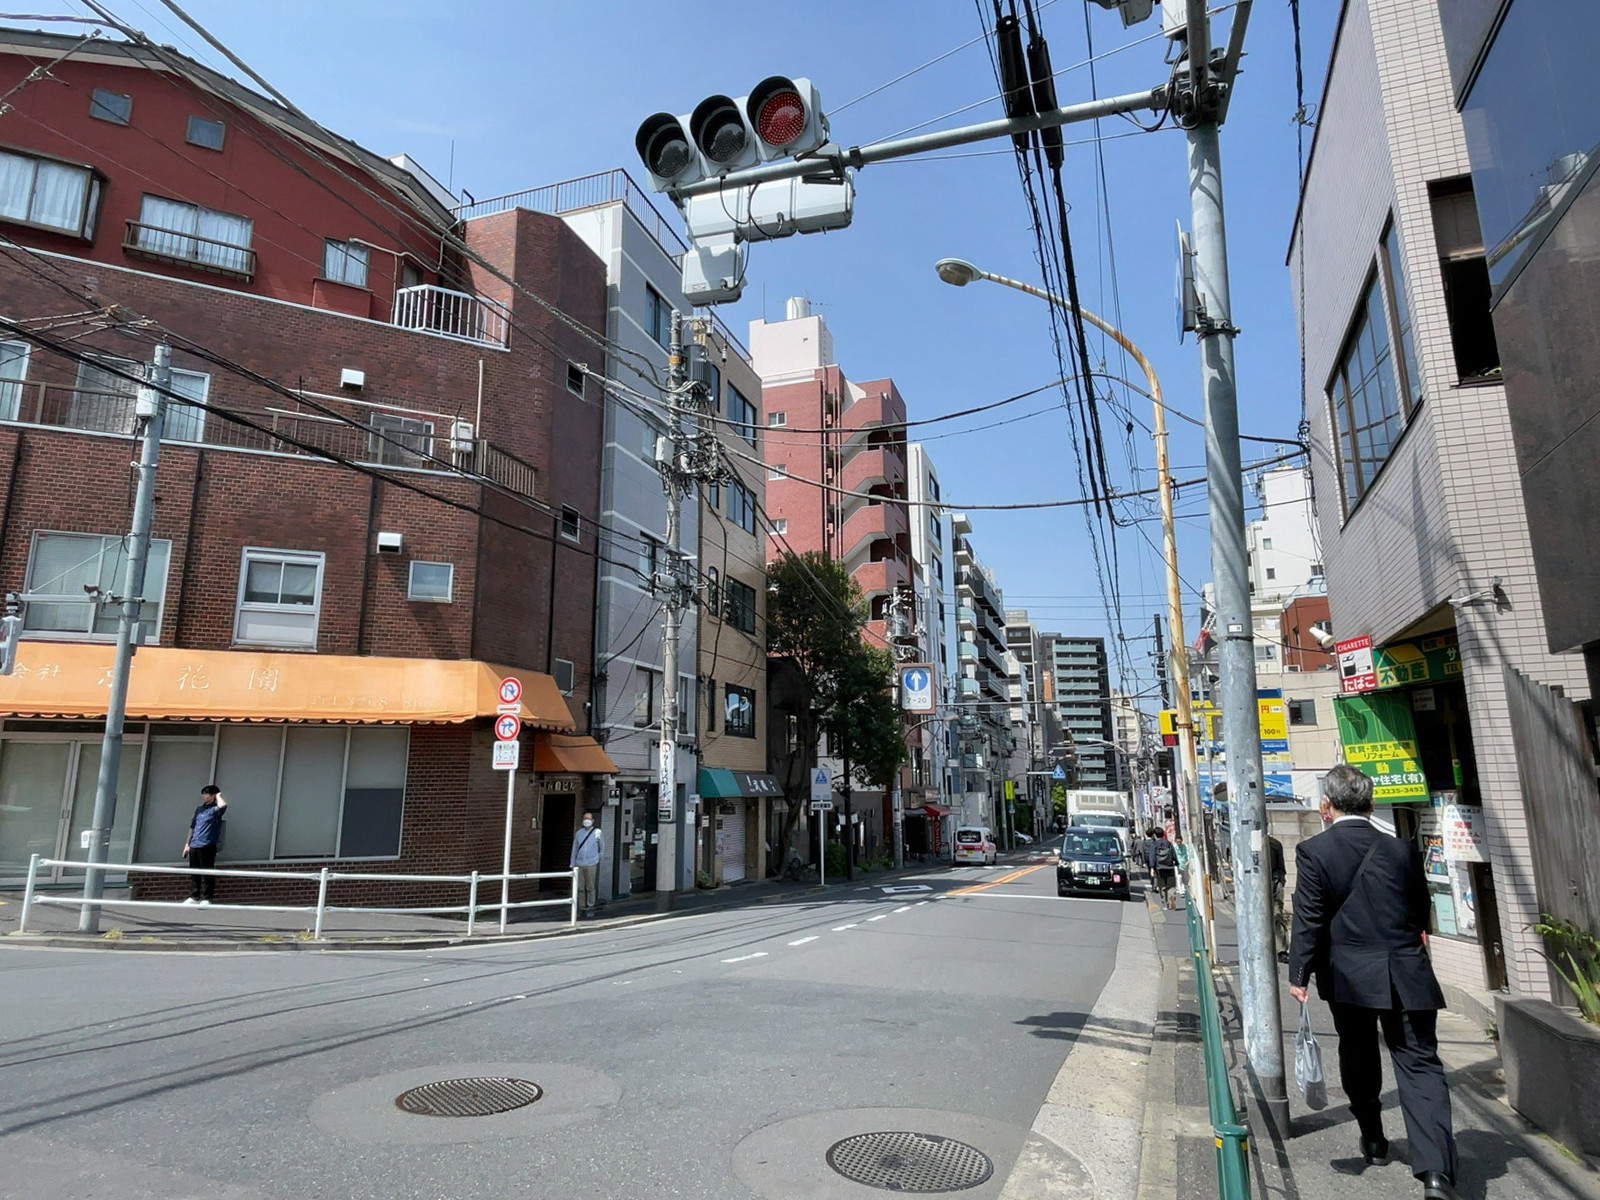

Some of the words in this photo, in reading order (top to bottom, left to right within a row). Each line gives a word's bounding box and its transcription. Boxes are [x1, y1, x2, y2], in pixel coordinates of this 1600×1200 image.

[1338, 638, 1369, 652] CIGARETTE
[1380, 662, 1426, 685] 不動産
[1343, 675, 1376, 692] たばこ
[1363, 751, 1400, 760] リフォーム
